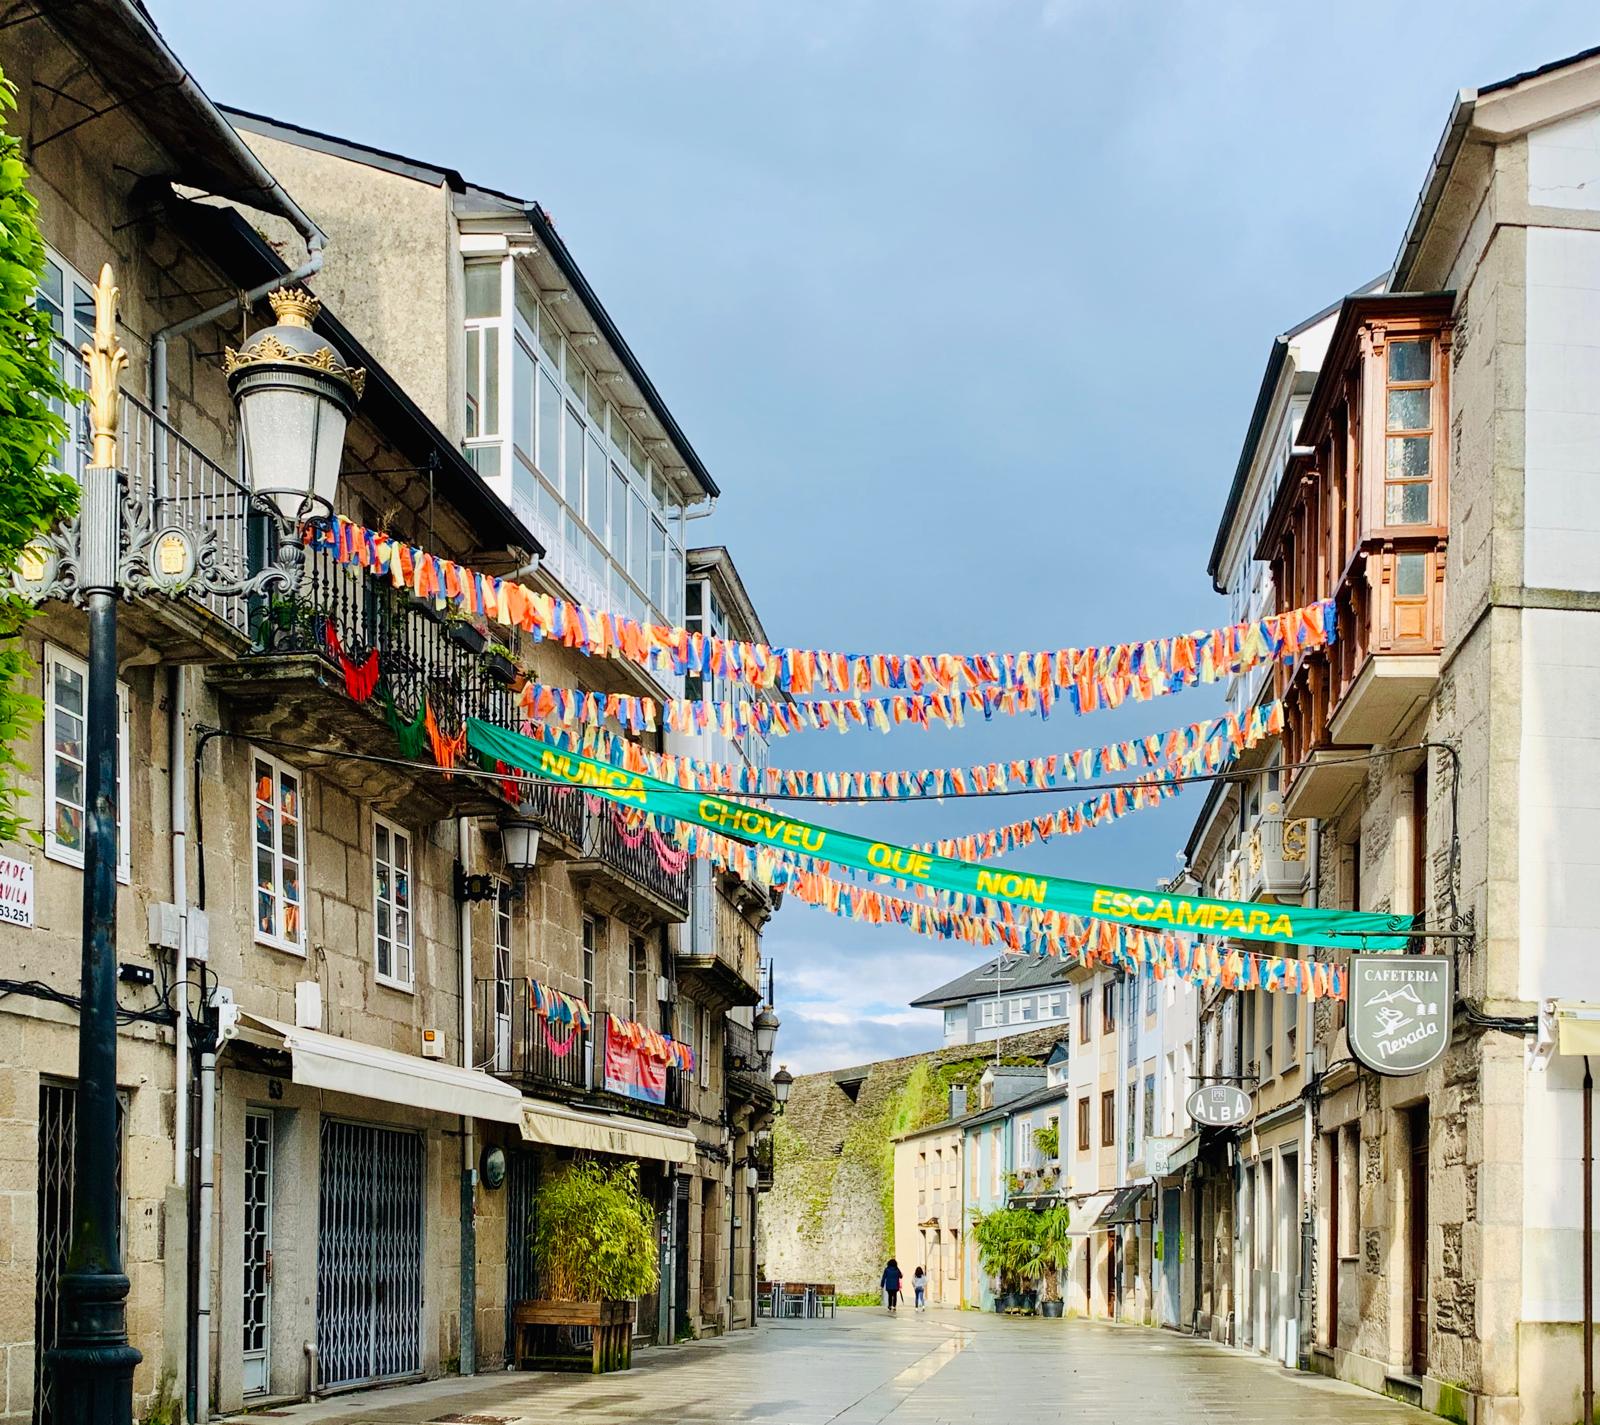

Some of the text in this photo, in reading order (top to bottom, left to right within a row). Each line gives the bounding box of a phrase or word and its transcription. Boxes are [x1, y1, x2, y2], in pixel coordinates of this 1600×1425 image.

[541, 750, 1293, 937] NUNCA CHOVEU QUE NON ESCAMPARA
[1364, 969, 1438, 982] CAFETERIA
[1195, 1094, 1245, 1121] ALBA
